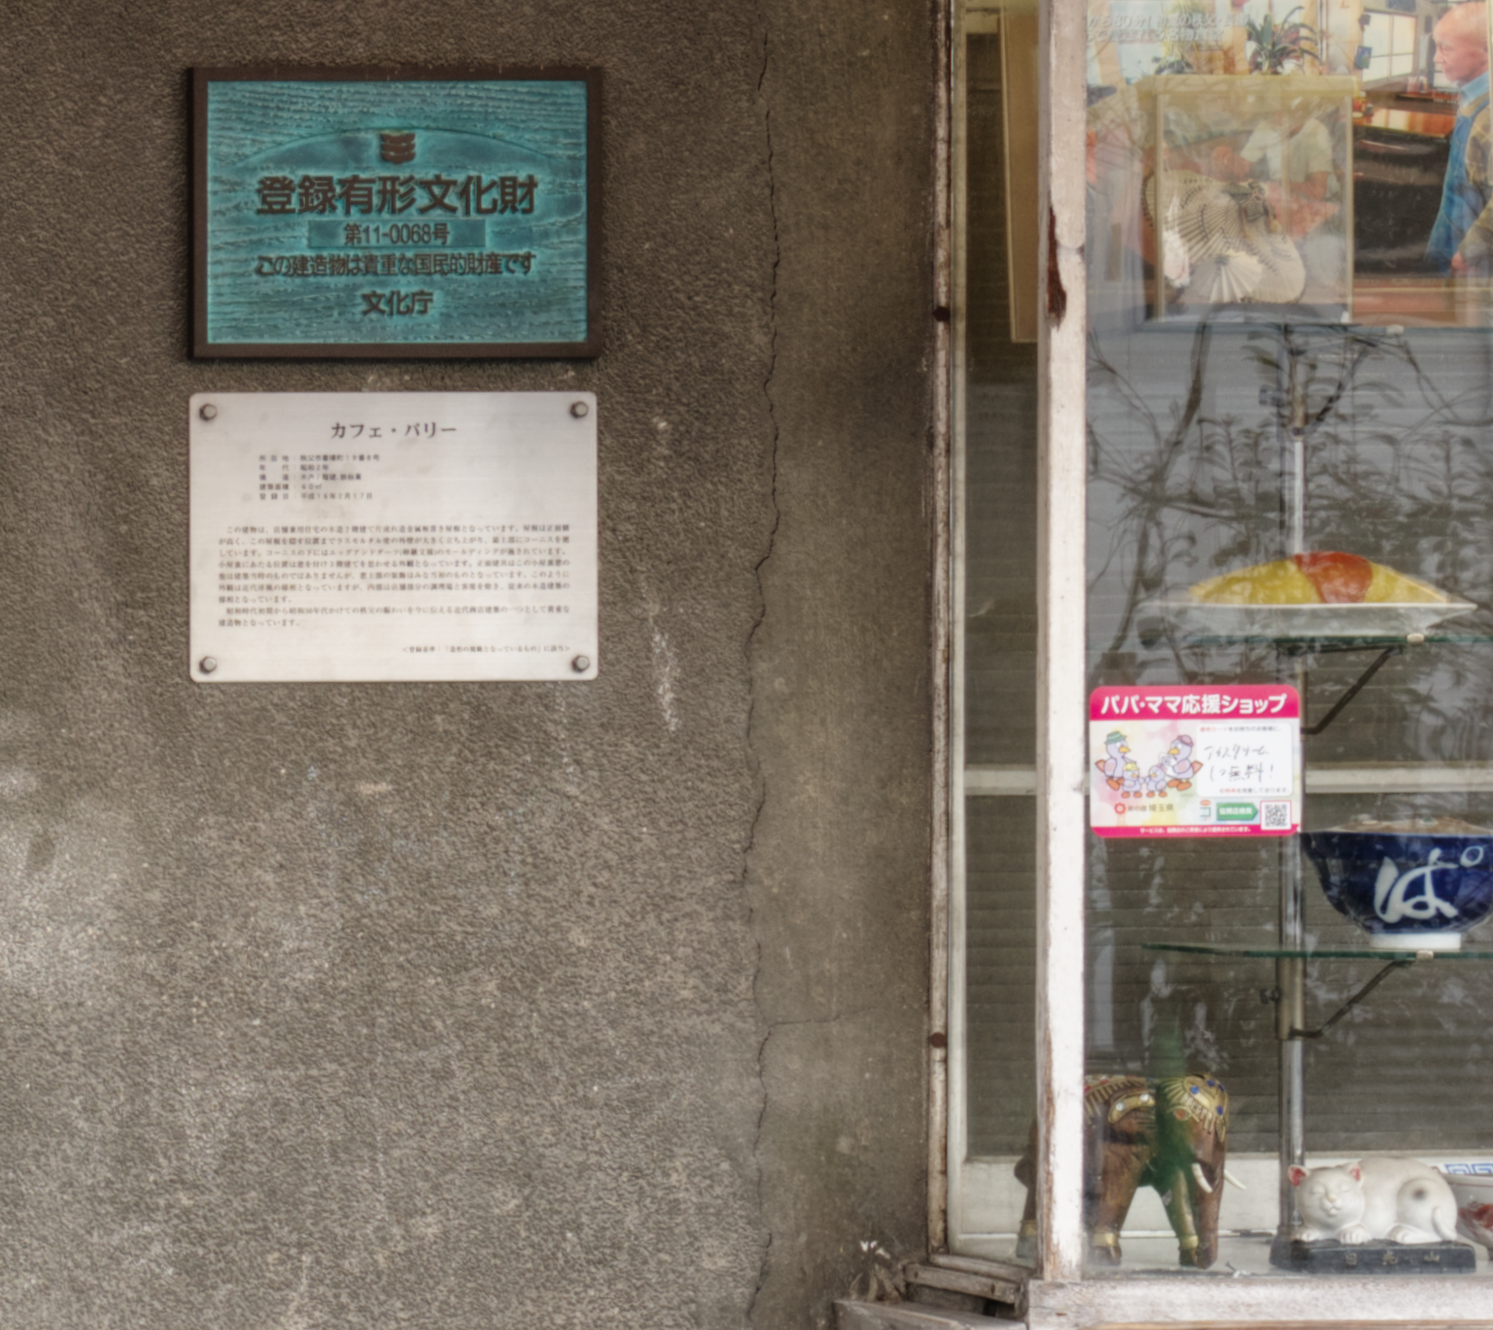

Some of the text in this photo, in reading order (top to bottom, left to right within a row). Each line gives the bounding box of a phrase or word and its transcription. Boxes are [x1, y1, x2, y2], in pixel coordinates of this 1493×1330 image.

[256, 174, 538, 215] 登録有形文化財
[343, 221, 451, 247] 第11-0068号
[255, 252, 535, 277] この建造物は貴重な国民的財産です
[361, 289, 433, 316] 文化庁
[1100, 693, 1288, 715] パパ・ママ応援ショップ
